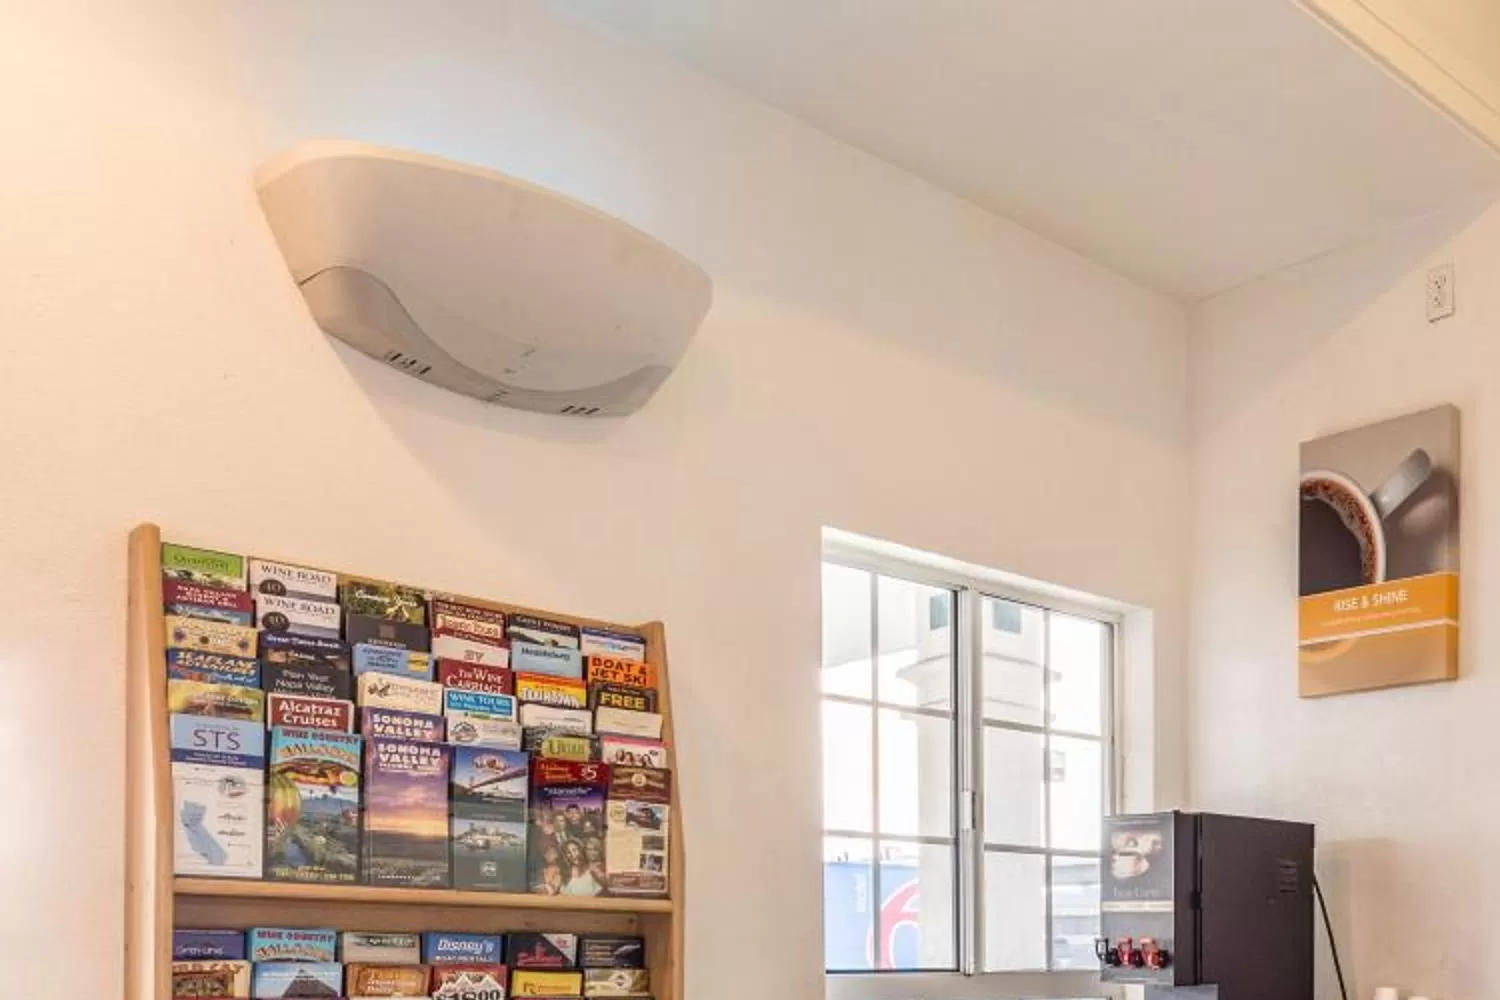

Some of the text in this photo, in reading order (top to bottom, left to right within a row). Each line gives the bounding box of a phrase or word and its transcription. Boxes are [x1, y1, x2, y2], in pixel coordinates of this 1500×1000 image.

[261, 563, 333, 584] WINE ROAD
[264, 597, 337, 616] WINE ROAD
[1333, 588, 1410, 613] RISE & SHINE
[591, 656, 648, 675] BOAT &
[472, 667, 504, 683] WINE
[591, 669, 647, 686] JET SKI
[274, 678, 304, 692] Napa
[305, 681, 336, 694] Valley
[278, 699, 343, 718] Alcatraz
[601, 691, 646, 711] FREE
[282, 712, 338, 728] Cruises
[373, 713, 434, 730] SONOMA
[373, 723, 430, 738] VALLEY
[192, 728, 241, 751] STS
[377, 742, 441, 758] SONOMA
[379, 753, 441, 767] VALLEY
[437, 937, 495, 954] Disney's
